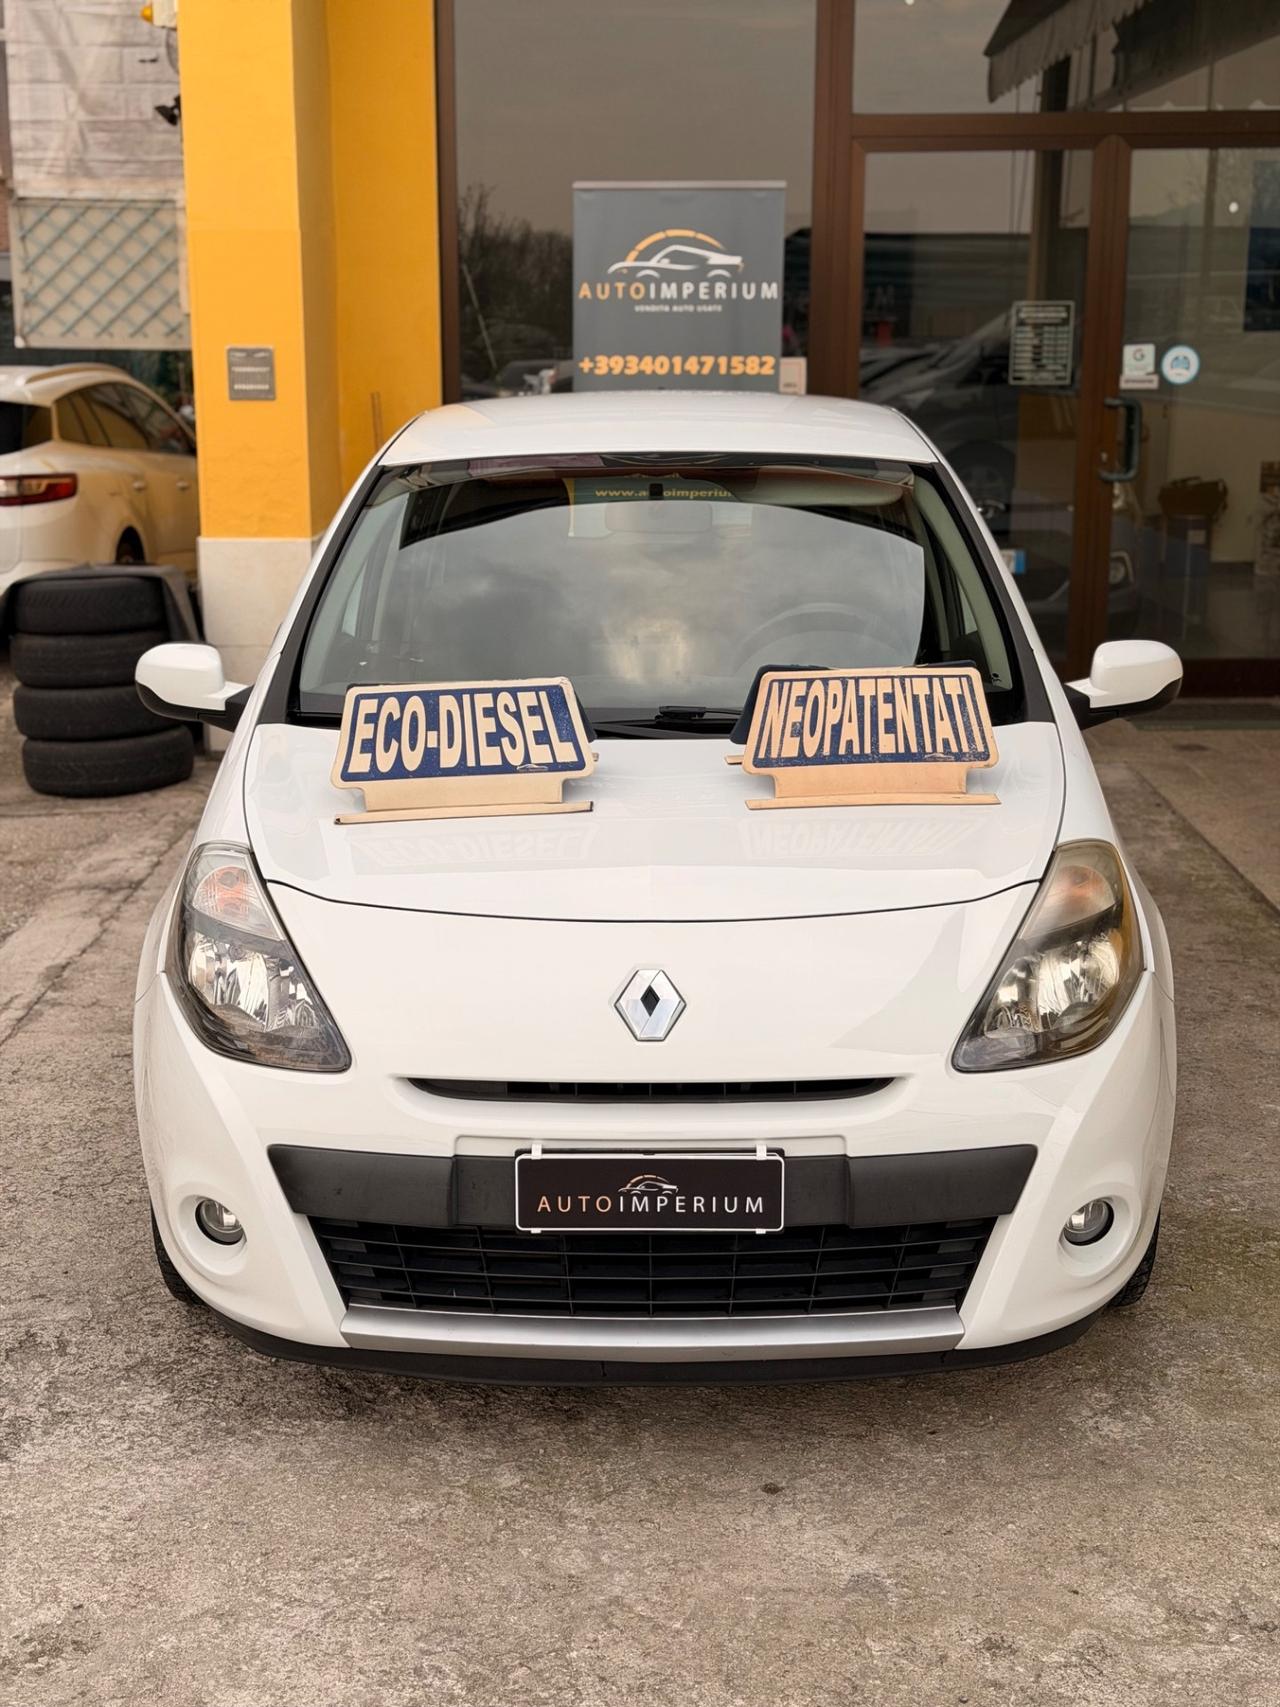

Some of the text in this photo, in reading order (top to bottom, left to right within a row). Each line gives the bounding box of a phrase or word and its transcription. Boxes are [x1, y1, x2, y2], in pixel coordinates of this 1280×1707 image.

[578, 282, 778, 300] AUTOIMPERIUM
[672, 304, 695, 313] AUTO
[579, 355, 776, 376] +393401471582
[595, 488, 732, 499] www.aoimperiu
[758, 677, 985, 759] NEOPATENTATI
[347, 691, 579, 773] ECO-DIESEL
[537, 1196, 763, 1214] AUTOIMPERIUM
